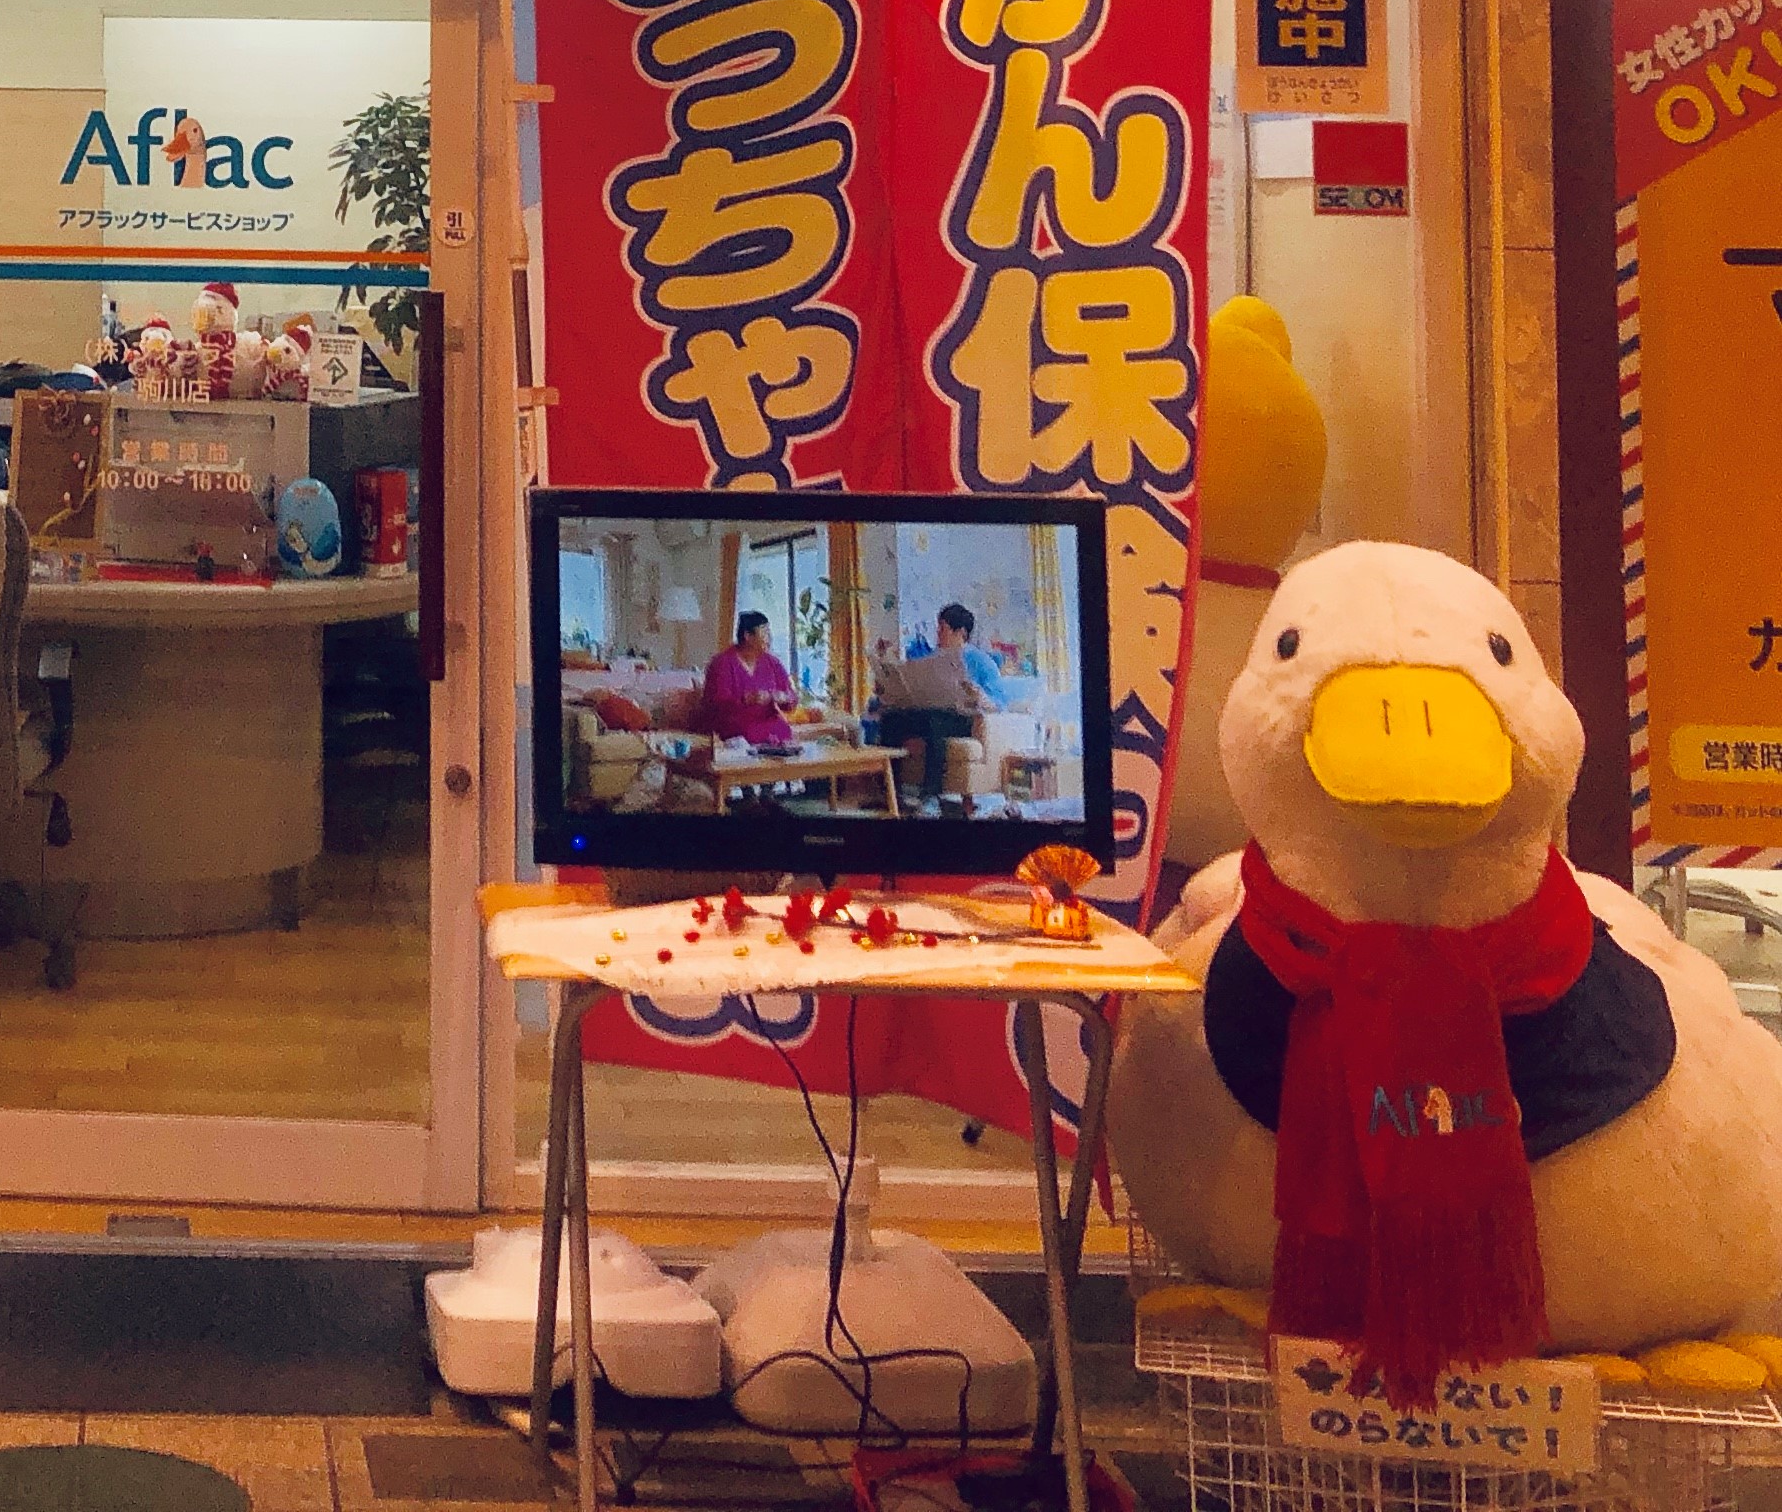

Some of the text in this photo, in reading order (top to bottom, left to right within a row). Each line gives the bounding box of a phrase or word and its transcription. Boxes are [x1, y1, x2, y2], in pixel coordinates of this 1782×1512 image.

[60, 106, 295, 190] Aflac
[58, 209, 295, 232] アフラックサービスショップ
